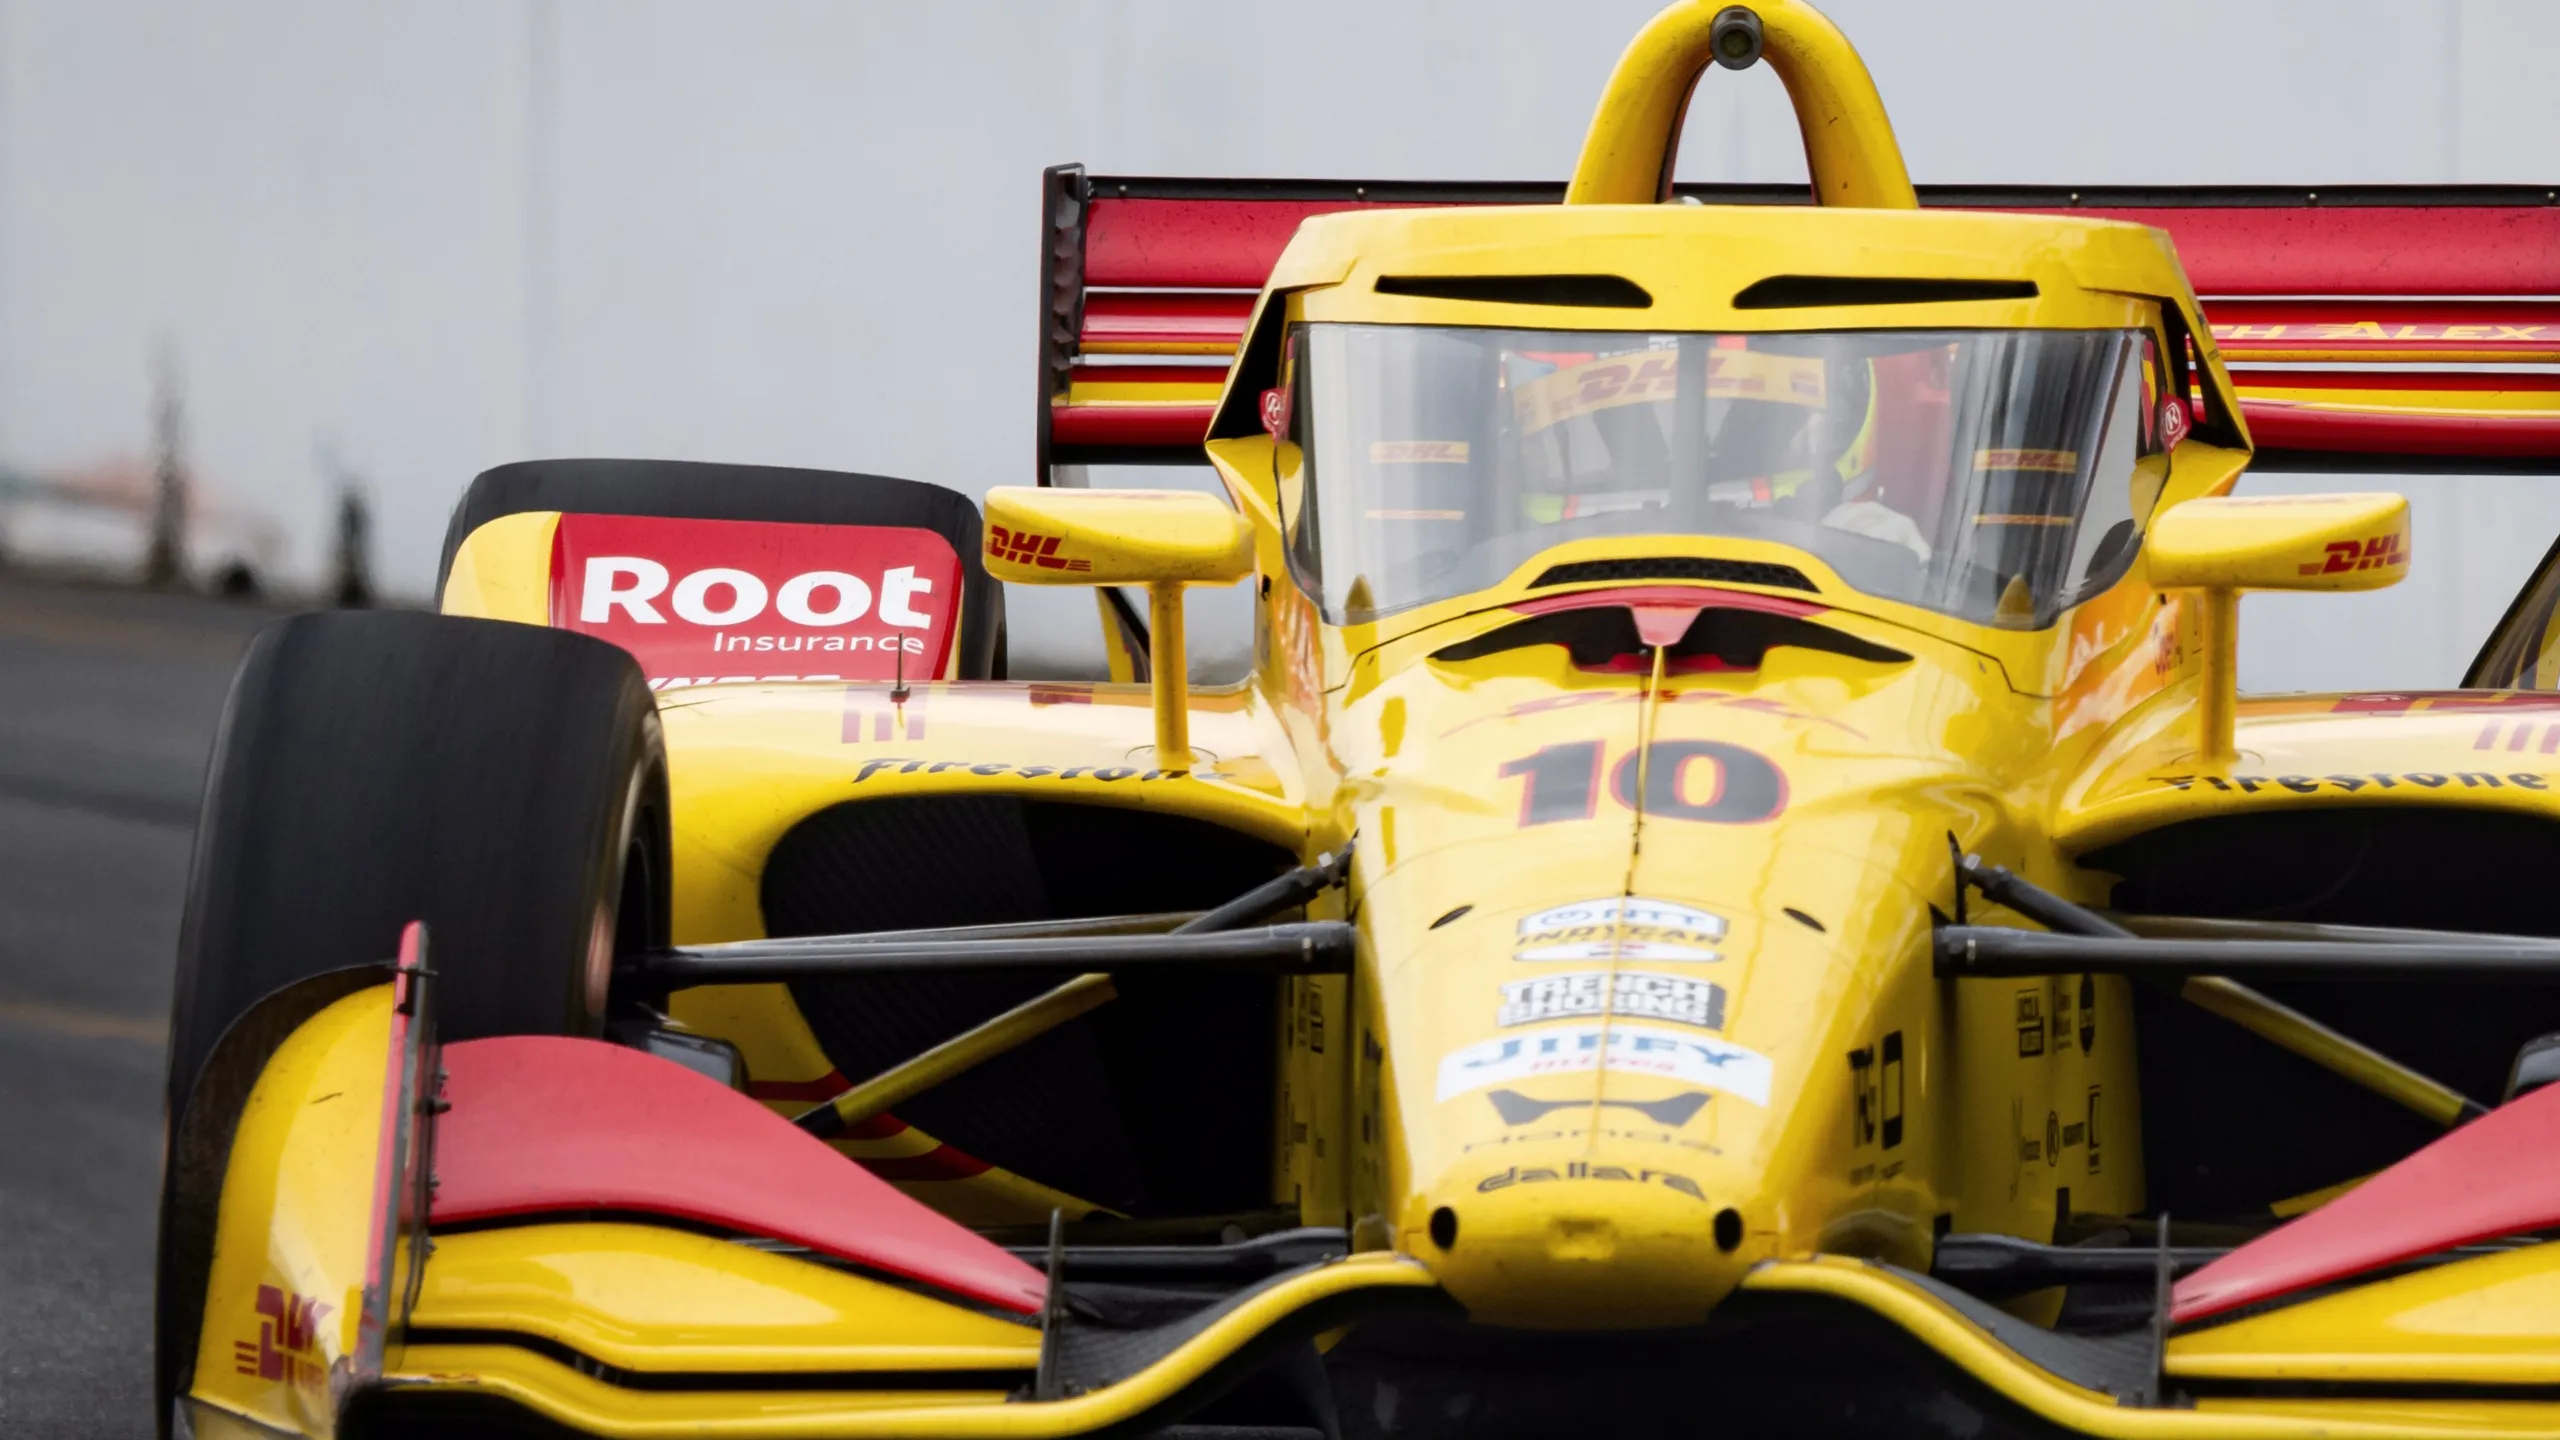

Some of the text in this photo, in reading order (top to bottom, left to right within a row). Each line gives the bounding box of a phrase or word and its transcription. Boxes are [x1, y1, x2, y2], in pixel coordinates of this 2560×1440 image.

[2317, 321, 2547, 340] ALEX
[990, 524, 1070, 570] DHL
[2322, 533, 2404, 575] DHL
[580, 556, 932, 630] Root
[713, 632, 925, 656] Insurance
[1498, 738, 1791, 829] 10
[2148, 771, 2551, 795] Firestone
[1508, 972, 1710, 1005] TRENCH
[1463, 1032, 1746, 1067] JIFFY
[1476, 1161, 1709, 1202] dallara
